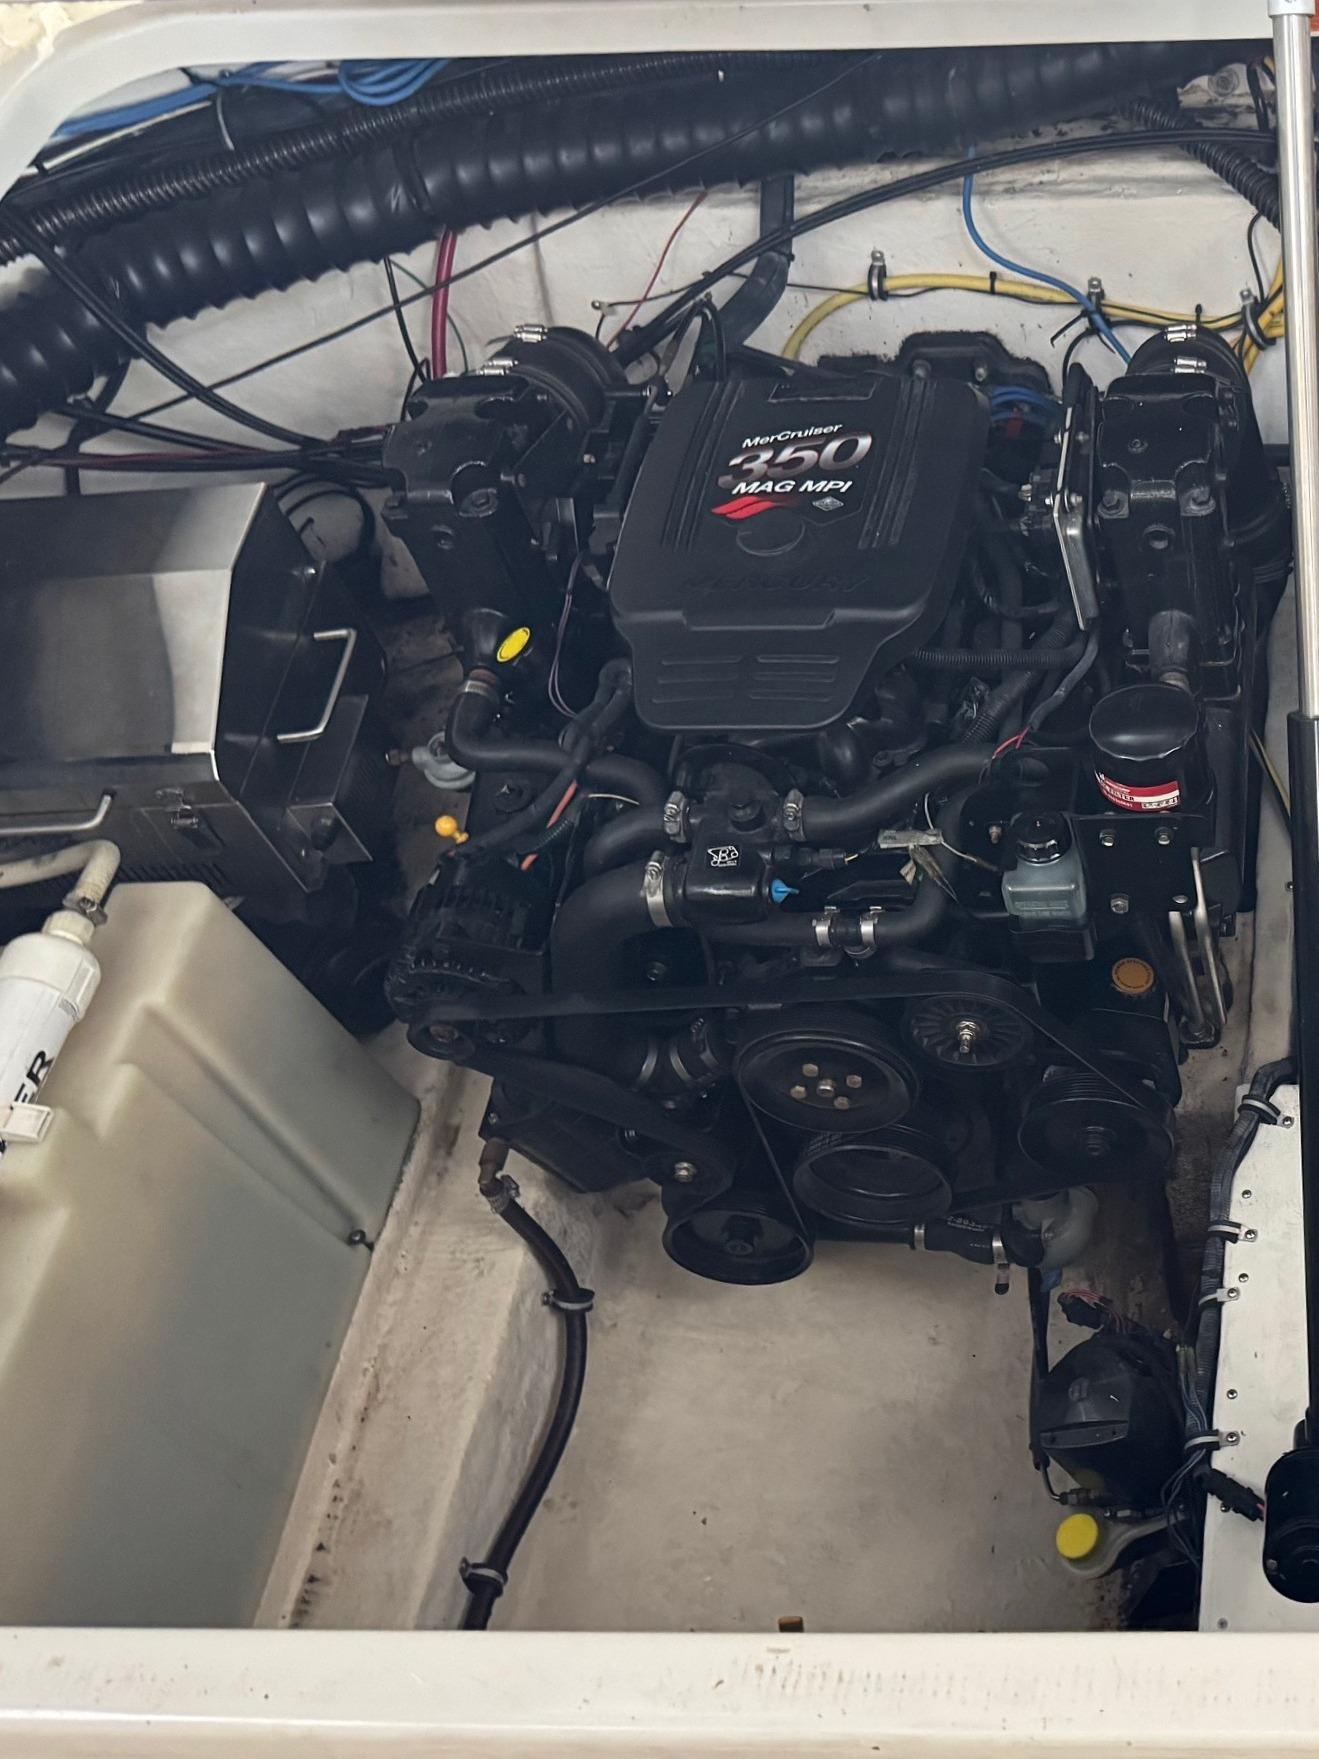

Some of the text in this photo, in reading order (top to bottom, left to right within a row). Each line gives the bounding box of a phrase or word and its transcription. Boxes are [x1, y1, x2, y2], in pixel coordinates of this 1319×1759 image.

[742, 424, 843, 449] MerCruiser
[717, 432, 873, 489] 350
[731, 480, 853, 495] MAG MPI
